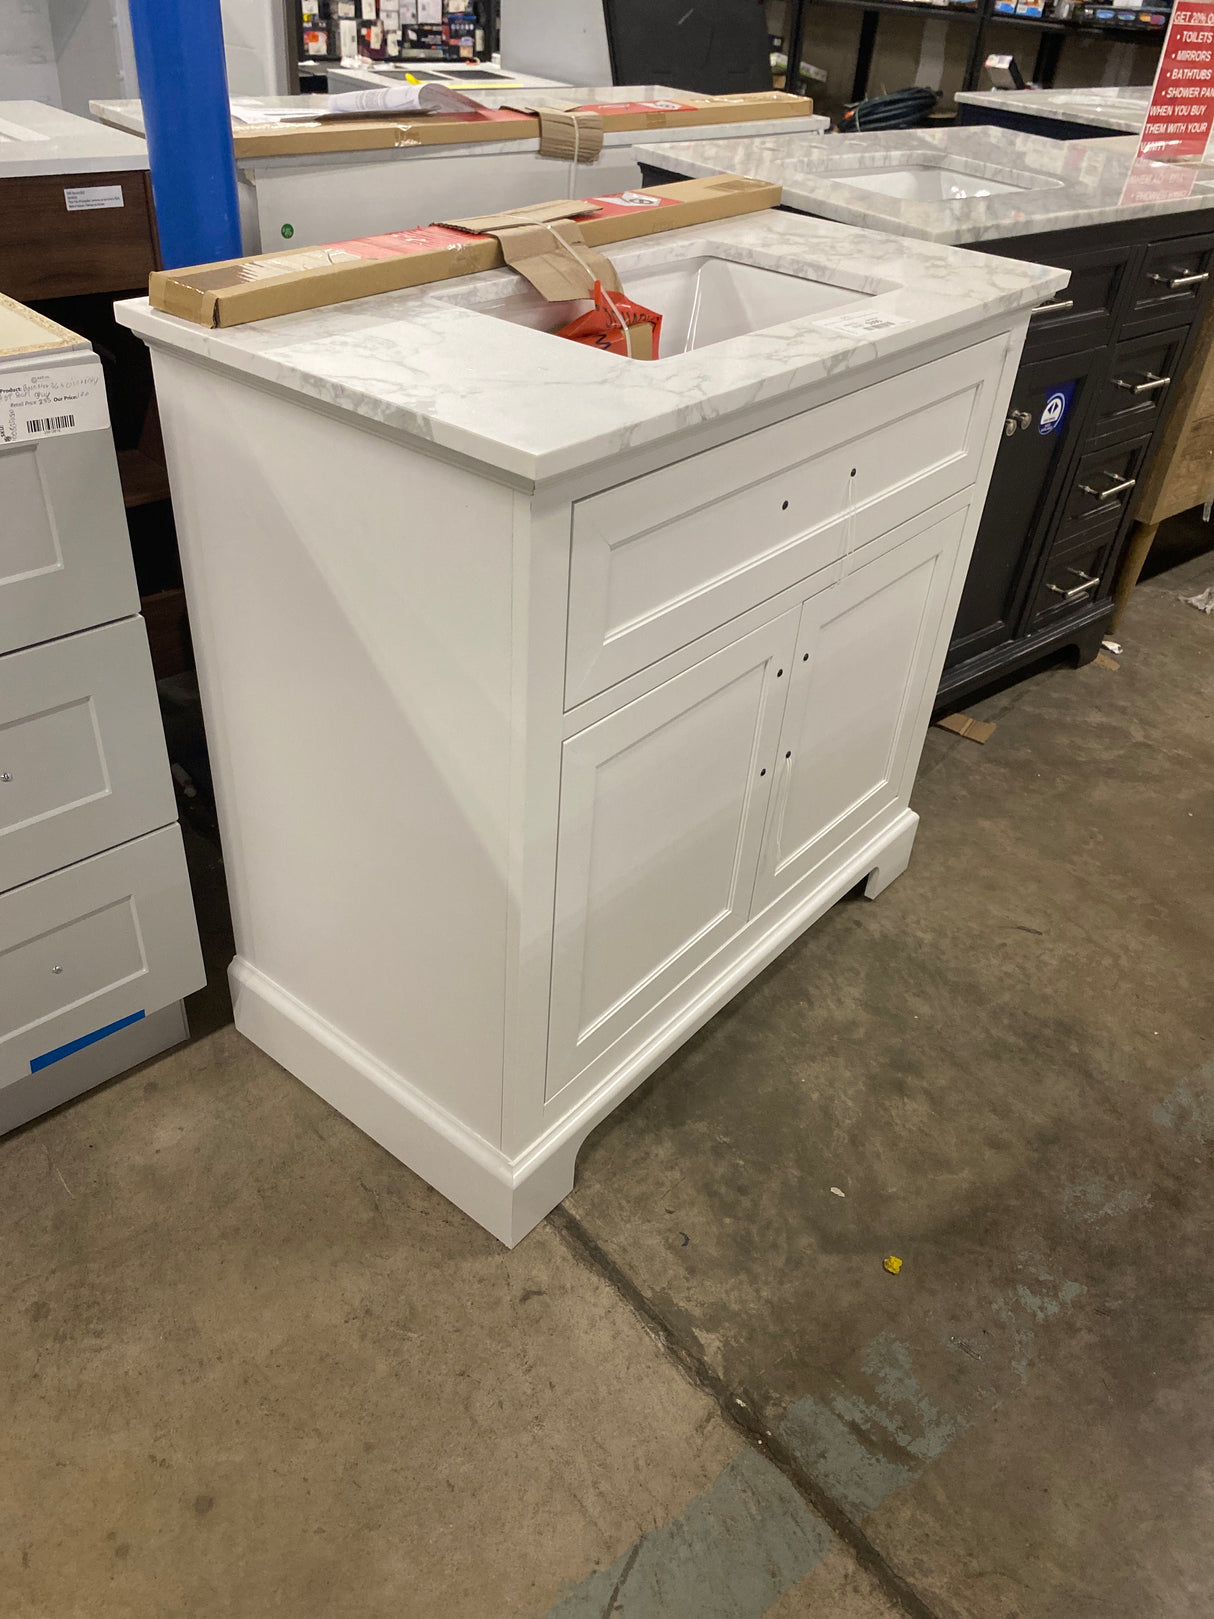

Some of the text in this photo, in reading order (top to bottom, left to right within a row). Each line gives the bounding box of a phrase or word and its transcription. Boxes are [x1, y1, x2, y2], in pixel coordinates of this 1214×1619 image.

[1175, 12, 1191, 23] GET
[1191, 12, 1206, 24] 20%
[1183, 31, 1213, 43] TOILETS
[1176, 50, 1212, 61] MIRRORS
[1172, 69, 1212, 80] BATHTUBS
[1166, 87, 1200, 98] SHOWER
[1150, 105, 1207, 116] WHEN YOU BUY
[1145, 123, 1208, 133] THEM WITH YOUR
